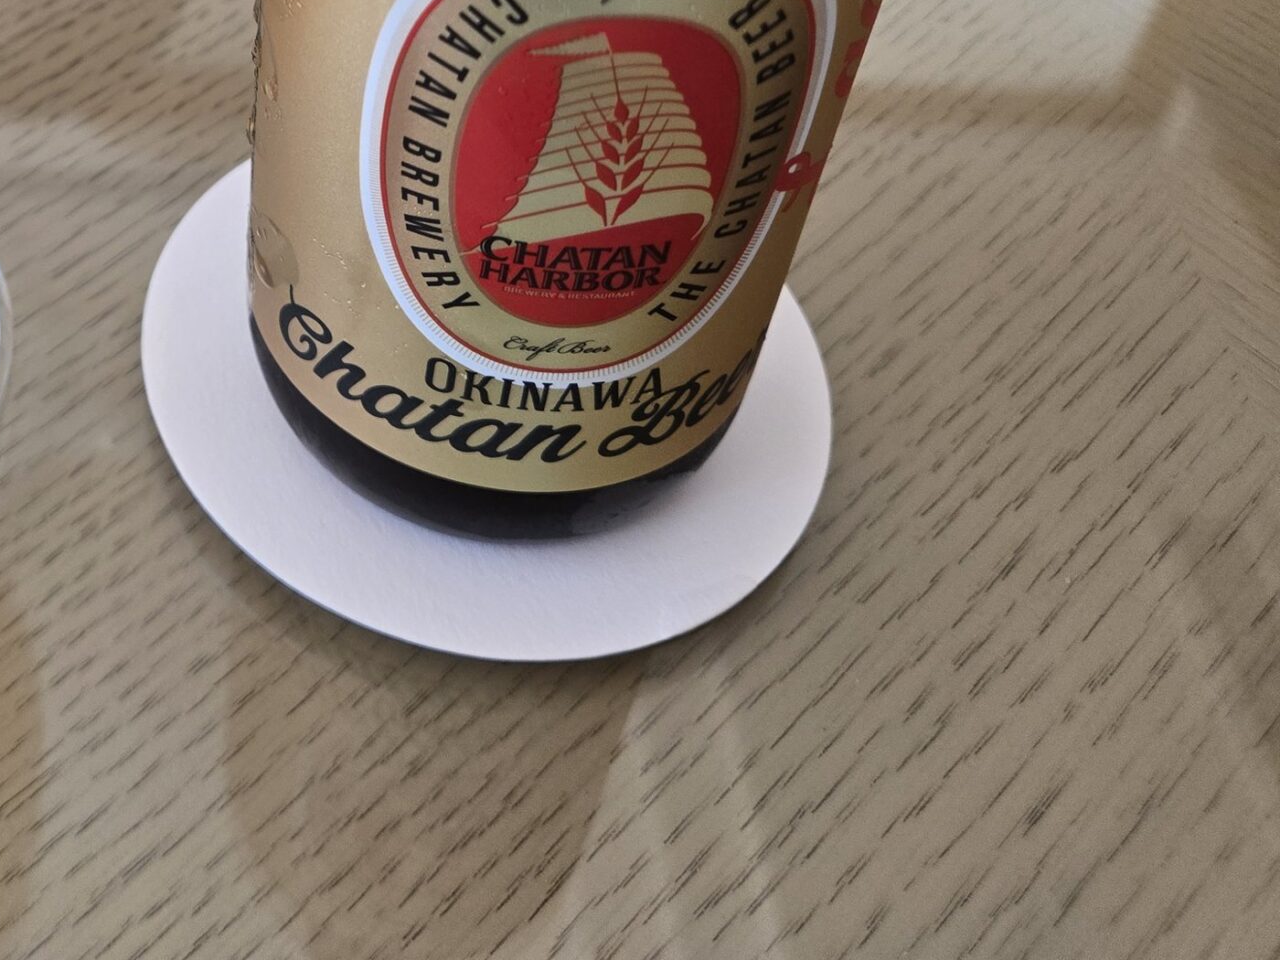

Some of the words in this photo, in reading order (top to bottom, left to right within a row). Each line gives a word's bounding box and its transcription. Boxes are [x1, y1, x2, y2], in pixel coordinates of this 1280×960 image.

[401, 136, 480, 309] BREWERY
[648, 259, 726, 323] THE
[713, 90, 792, 239] CHATAN
[479, 235, 672, 272] CHATAN
[479, 259, 668, 291] HARBOR
[504, 286, 558, 299] BREWERY
[568, 290, 635, 300] RESTAURANT
[503, 336, 566, 361] Craft
[557, 340, 611, 354] Beer
[279, 284, 588, 464] Chatan
[424, 356, 663, 413] OKINAWA
